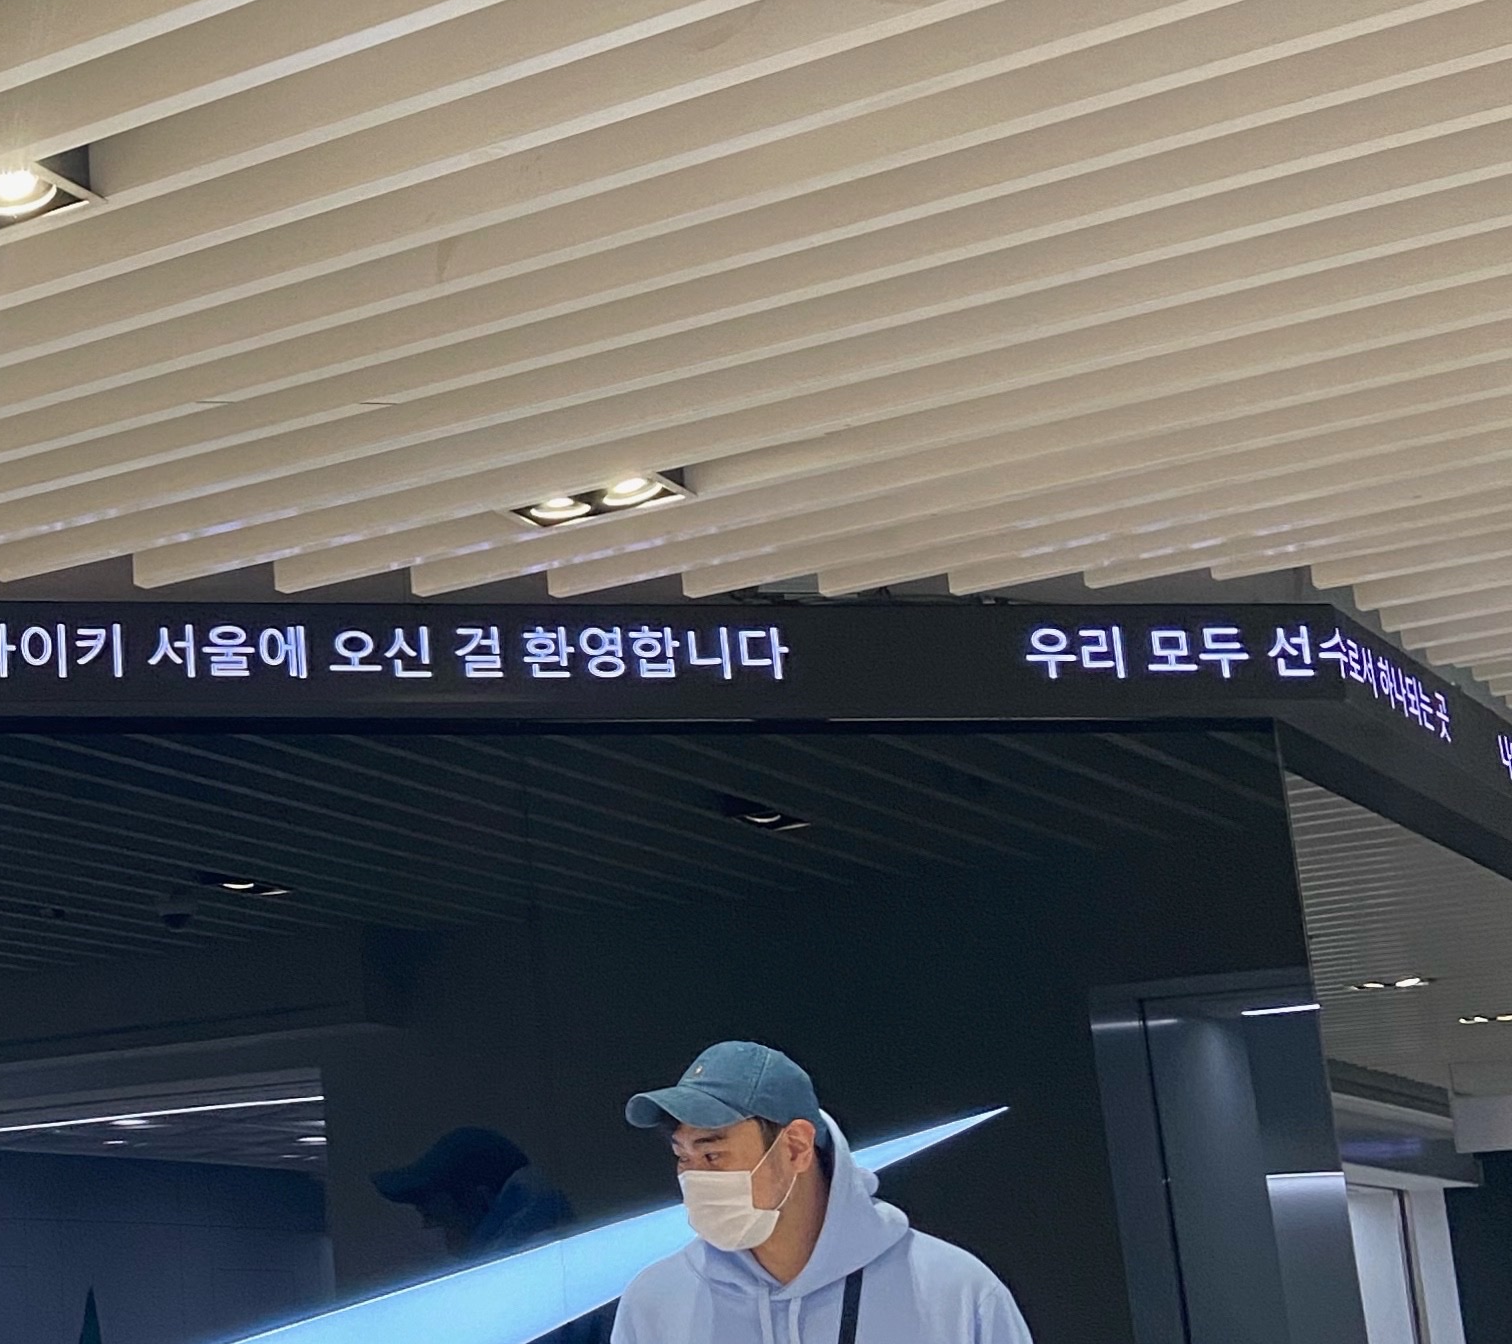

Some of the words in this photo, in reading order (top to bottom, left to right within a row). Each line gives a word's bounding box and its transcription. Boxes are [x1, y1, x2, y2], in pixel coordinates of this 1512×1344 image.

[147, 623, 308, 679] 서울에
[328, 625, 433, 678] 오신
[454, 626, 504, 678] 걸
[522, 625, 790, 680] 환영합니다
[1025, 625, 1126, 680] 우리
[1147, 627, 1250, 679] 모두
[1268, 625, 1379, 699] 선수로서
[1377, 656, 1436, 732] 하나되는
[1434, 691, 1453, 743] 곳
